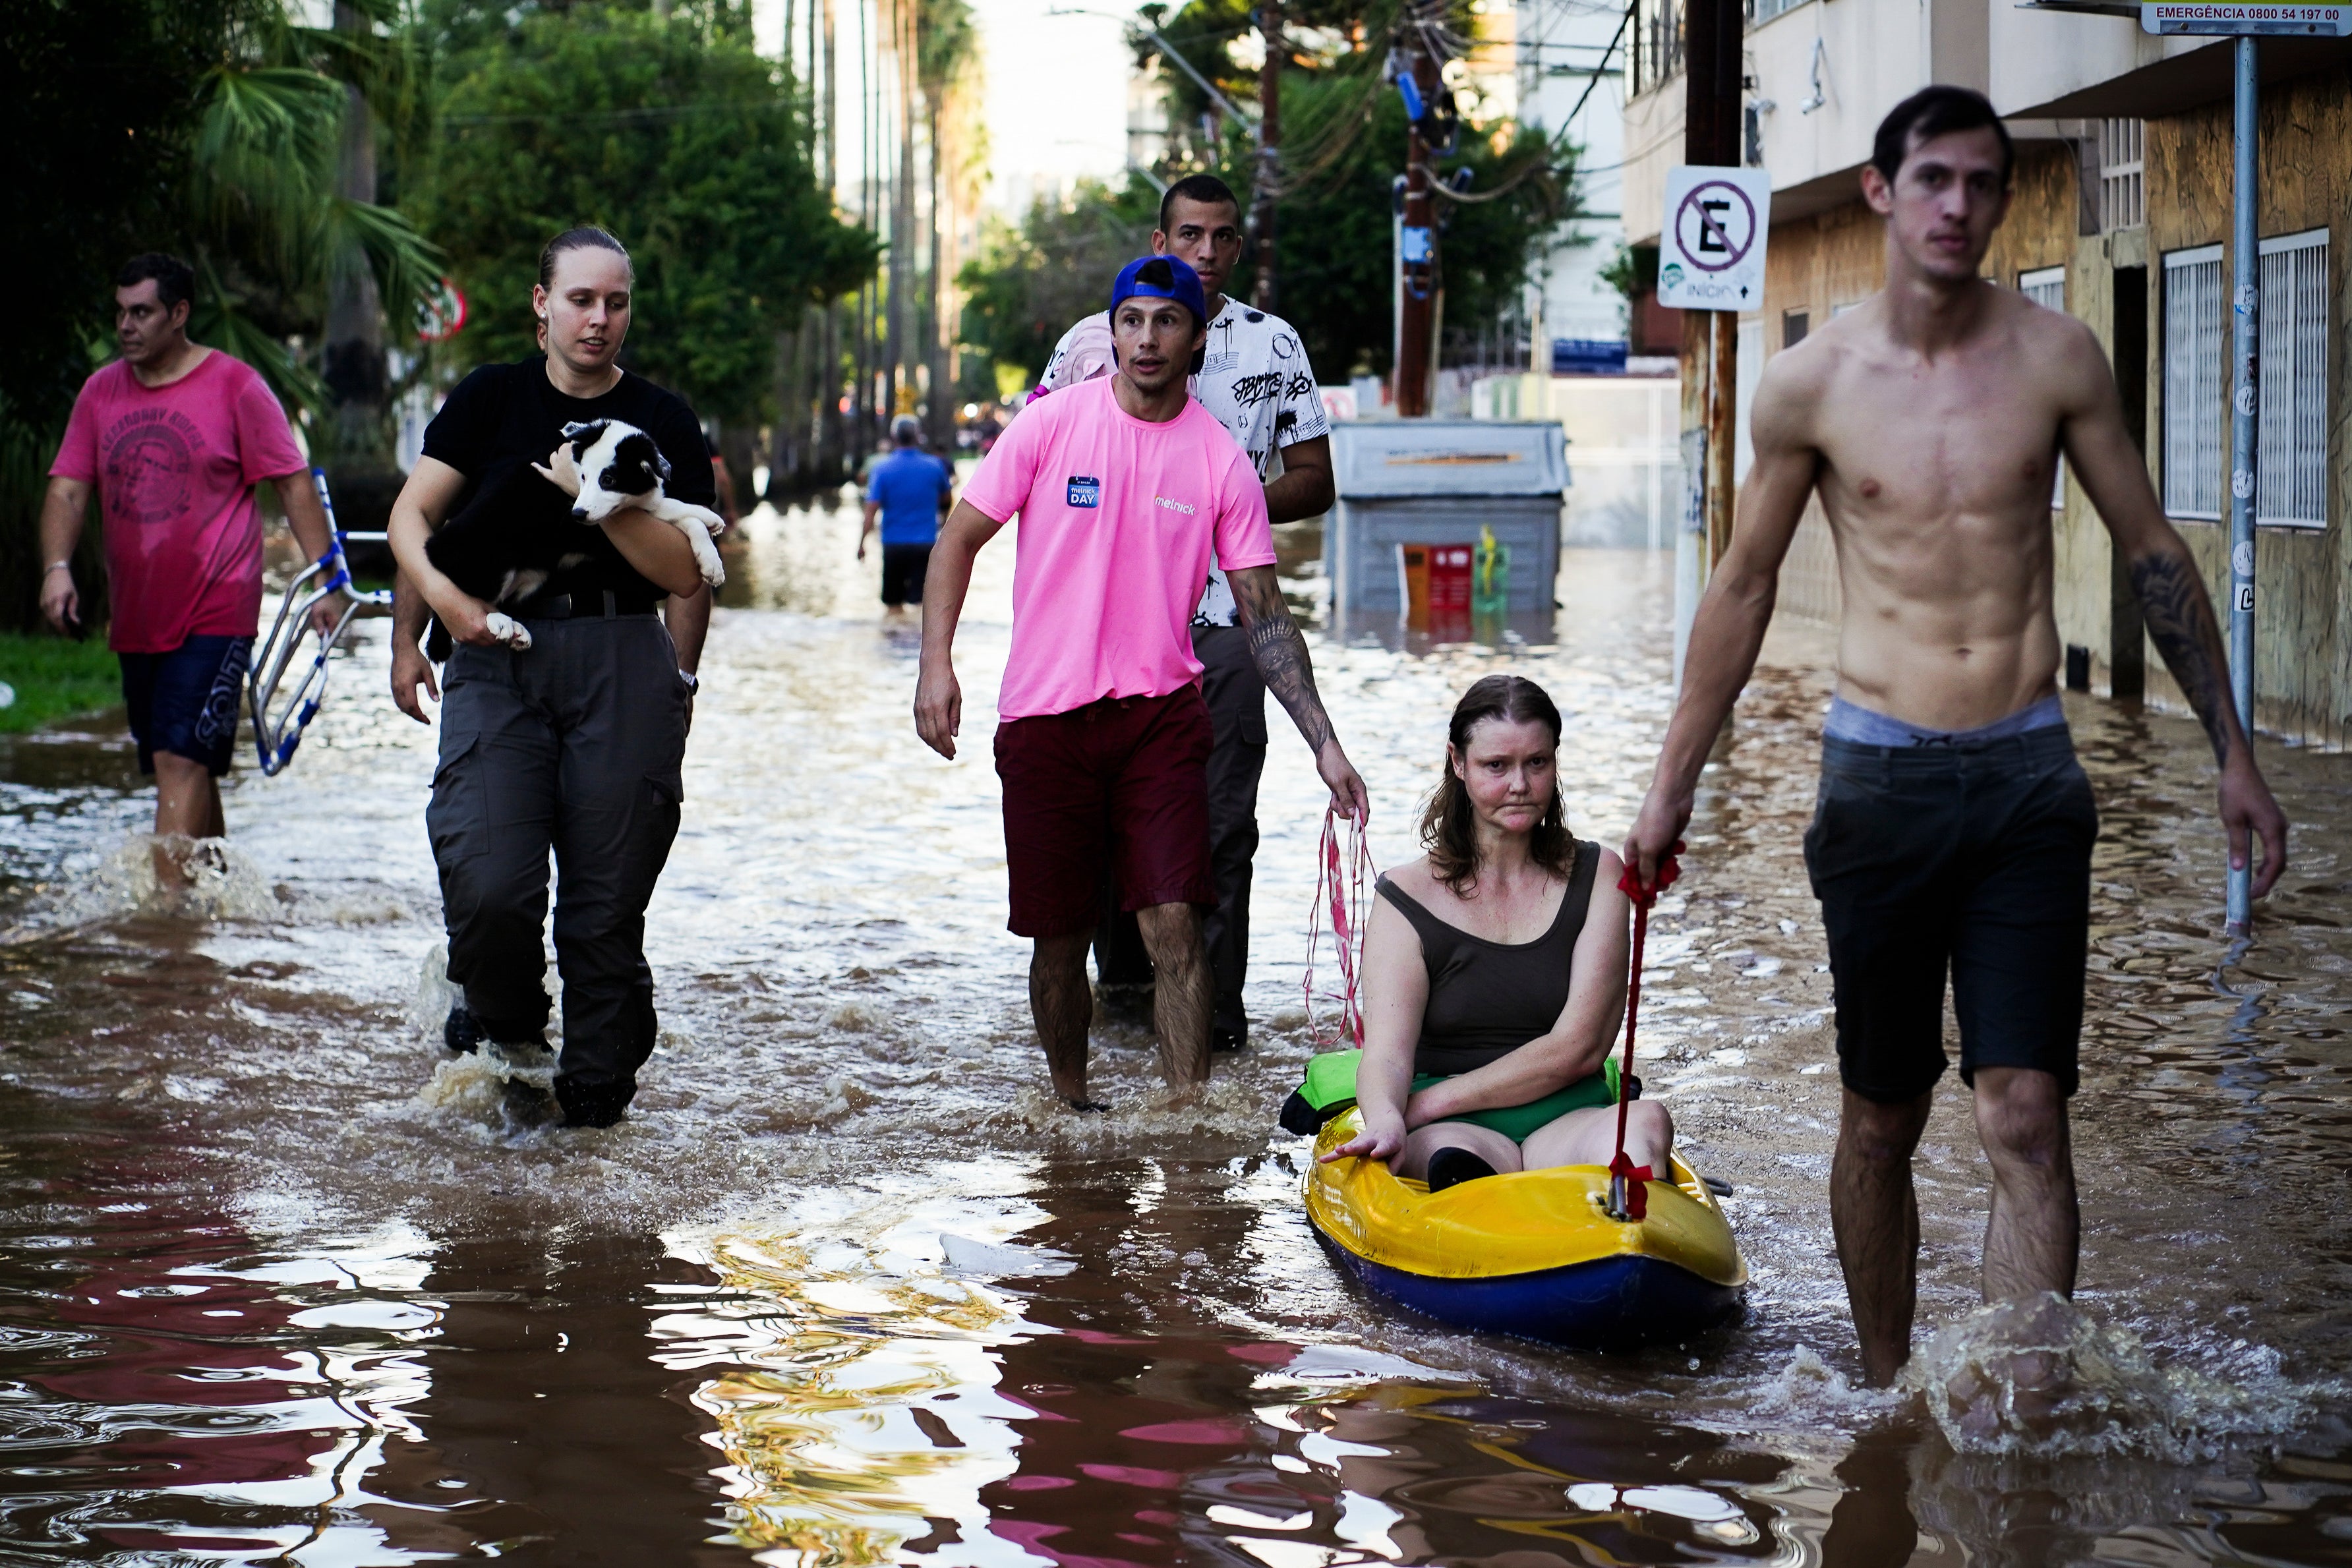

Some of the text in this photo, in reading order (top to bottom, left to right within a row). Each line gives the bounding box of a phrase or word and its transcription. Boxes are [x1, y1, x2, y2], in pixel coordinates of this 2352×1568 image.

[2156, 5, 2339, 20] EMERGÊNCIA 0800 54 197 00
[1699, 200, 1730, 252] E
[1071, 494, 1095, 504] DAY
[1154, 495, 1196, 516] melnick
